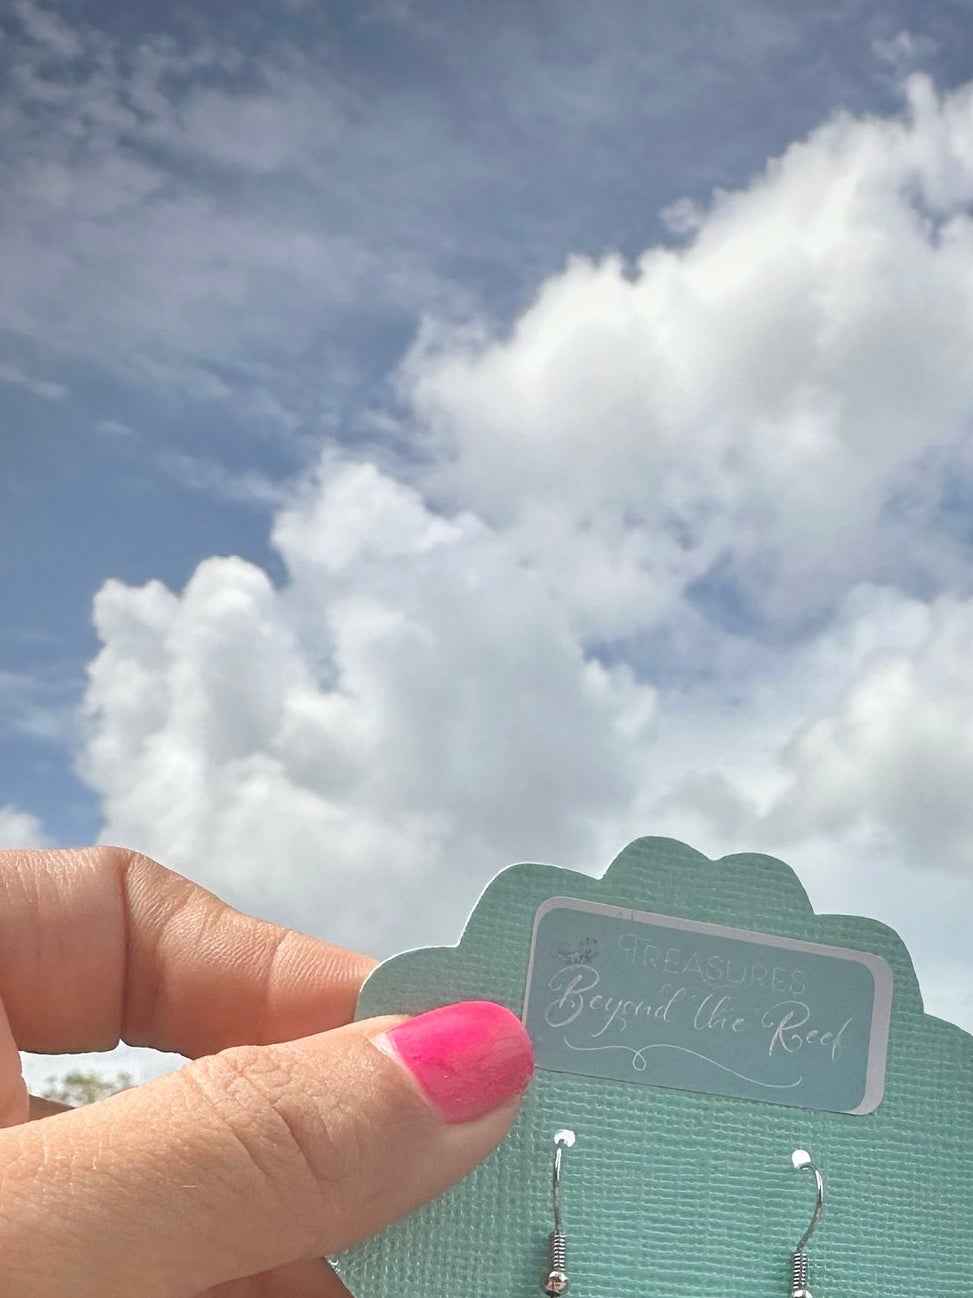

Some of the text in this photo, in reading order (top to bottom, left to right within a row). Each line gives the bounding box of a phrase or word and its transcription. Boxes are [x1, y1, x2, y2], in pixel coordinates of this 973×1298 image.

[617, 933, 807, 995] TREASURES
[545, 963, 854, 1062] Beyond the Reef
